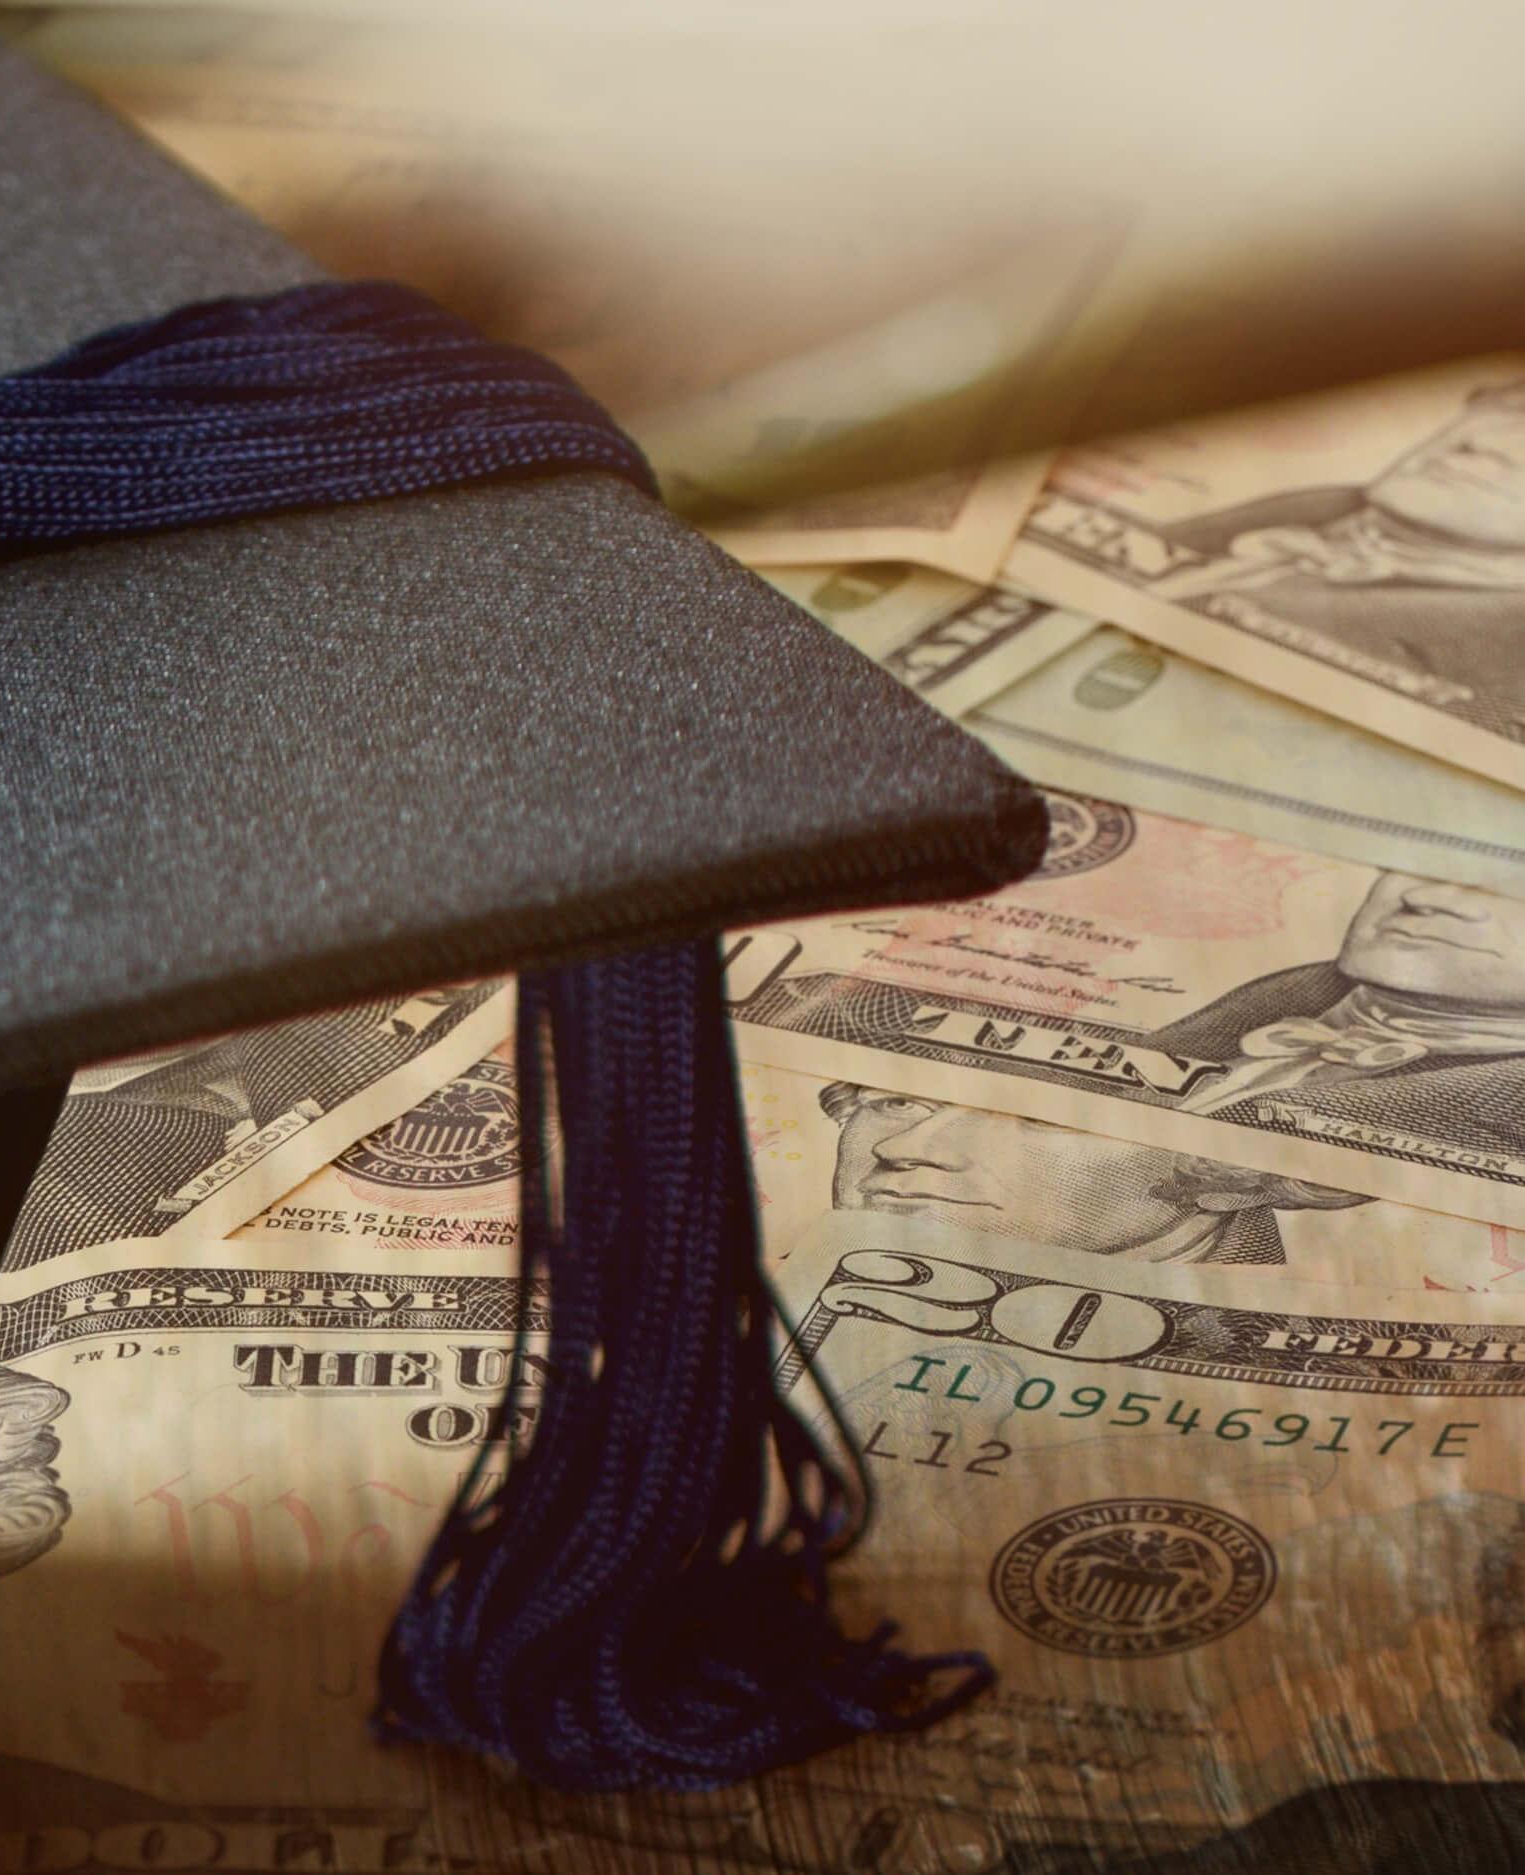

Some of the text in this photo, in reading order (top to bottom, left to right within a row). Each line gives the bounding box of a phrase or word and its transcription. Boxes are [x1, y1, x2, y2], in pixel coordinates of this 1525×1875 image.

[992, 914, 1040, 931] AND
[1046, 925, 1139, 952] PRIVATE
[194, 1116, 301, 1197] JACKSON
[363, 1158, 485, 1182] RESERVE
[1320, 1122, 1510, 1173] HAMILTON
[279, 1206, 348, 1222] NOTE
[354, 1211, 379, 1224] IS
[385, 1213, 465, 1231] LEGAL
[361, 1224, 455, 1243] PUBLIC
[461, 1232, 516, 1247] AND
[55, 1286, 467, 1323] RESERVE
[818, 1248, 1177, 1364] 20
[116, 1341, 141, 1359] D
[152, 1345, 181, 1357] 45
[233, 1343, 443, 1397] THE
[893, 1355, 982, 1402] IL
[861, 1421, 1013, 1476] L12
[1056, 1505, 1252, 1557] UNITED STATES
